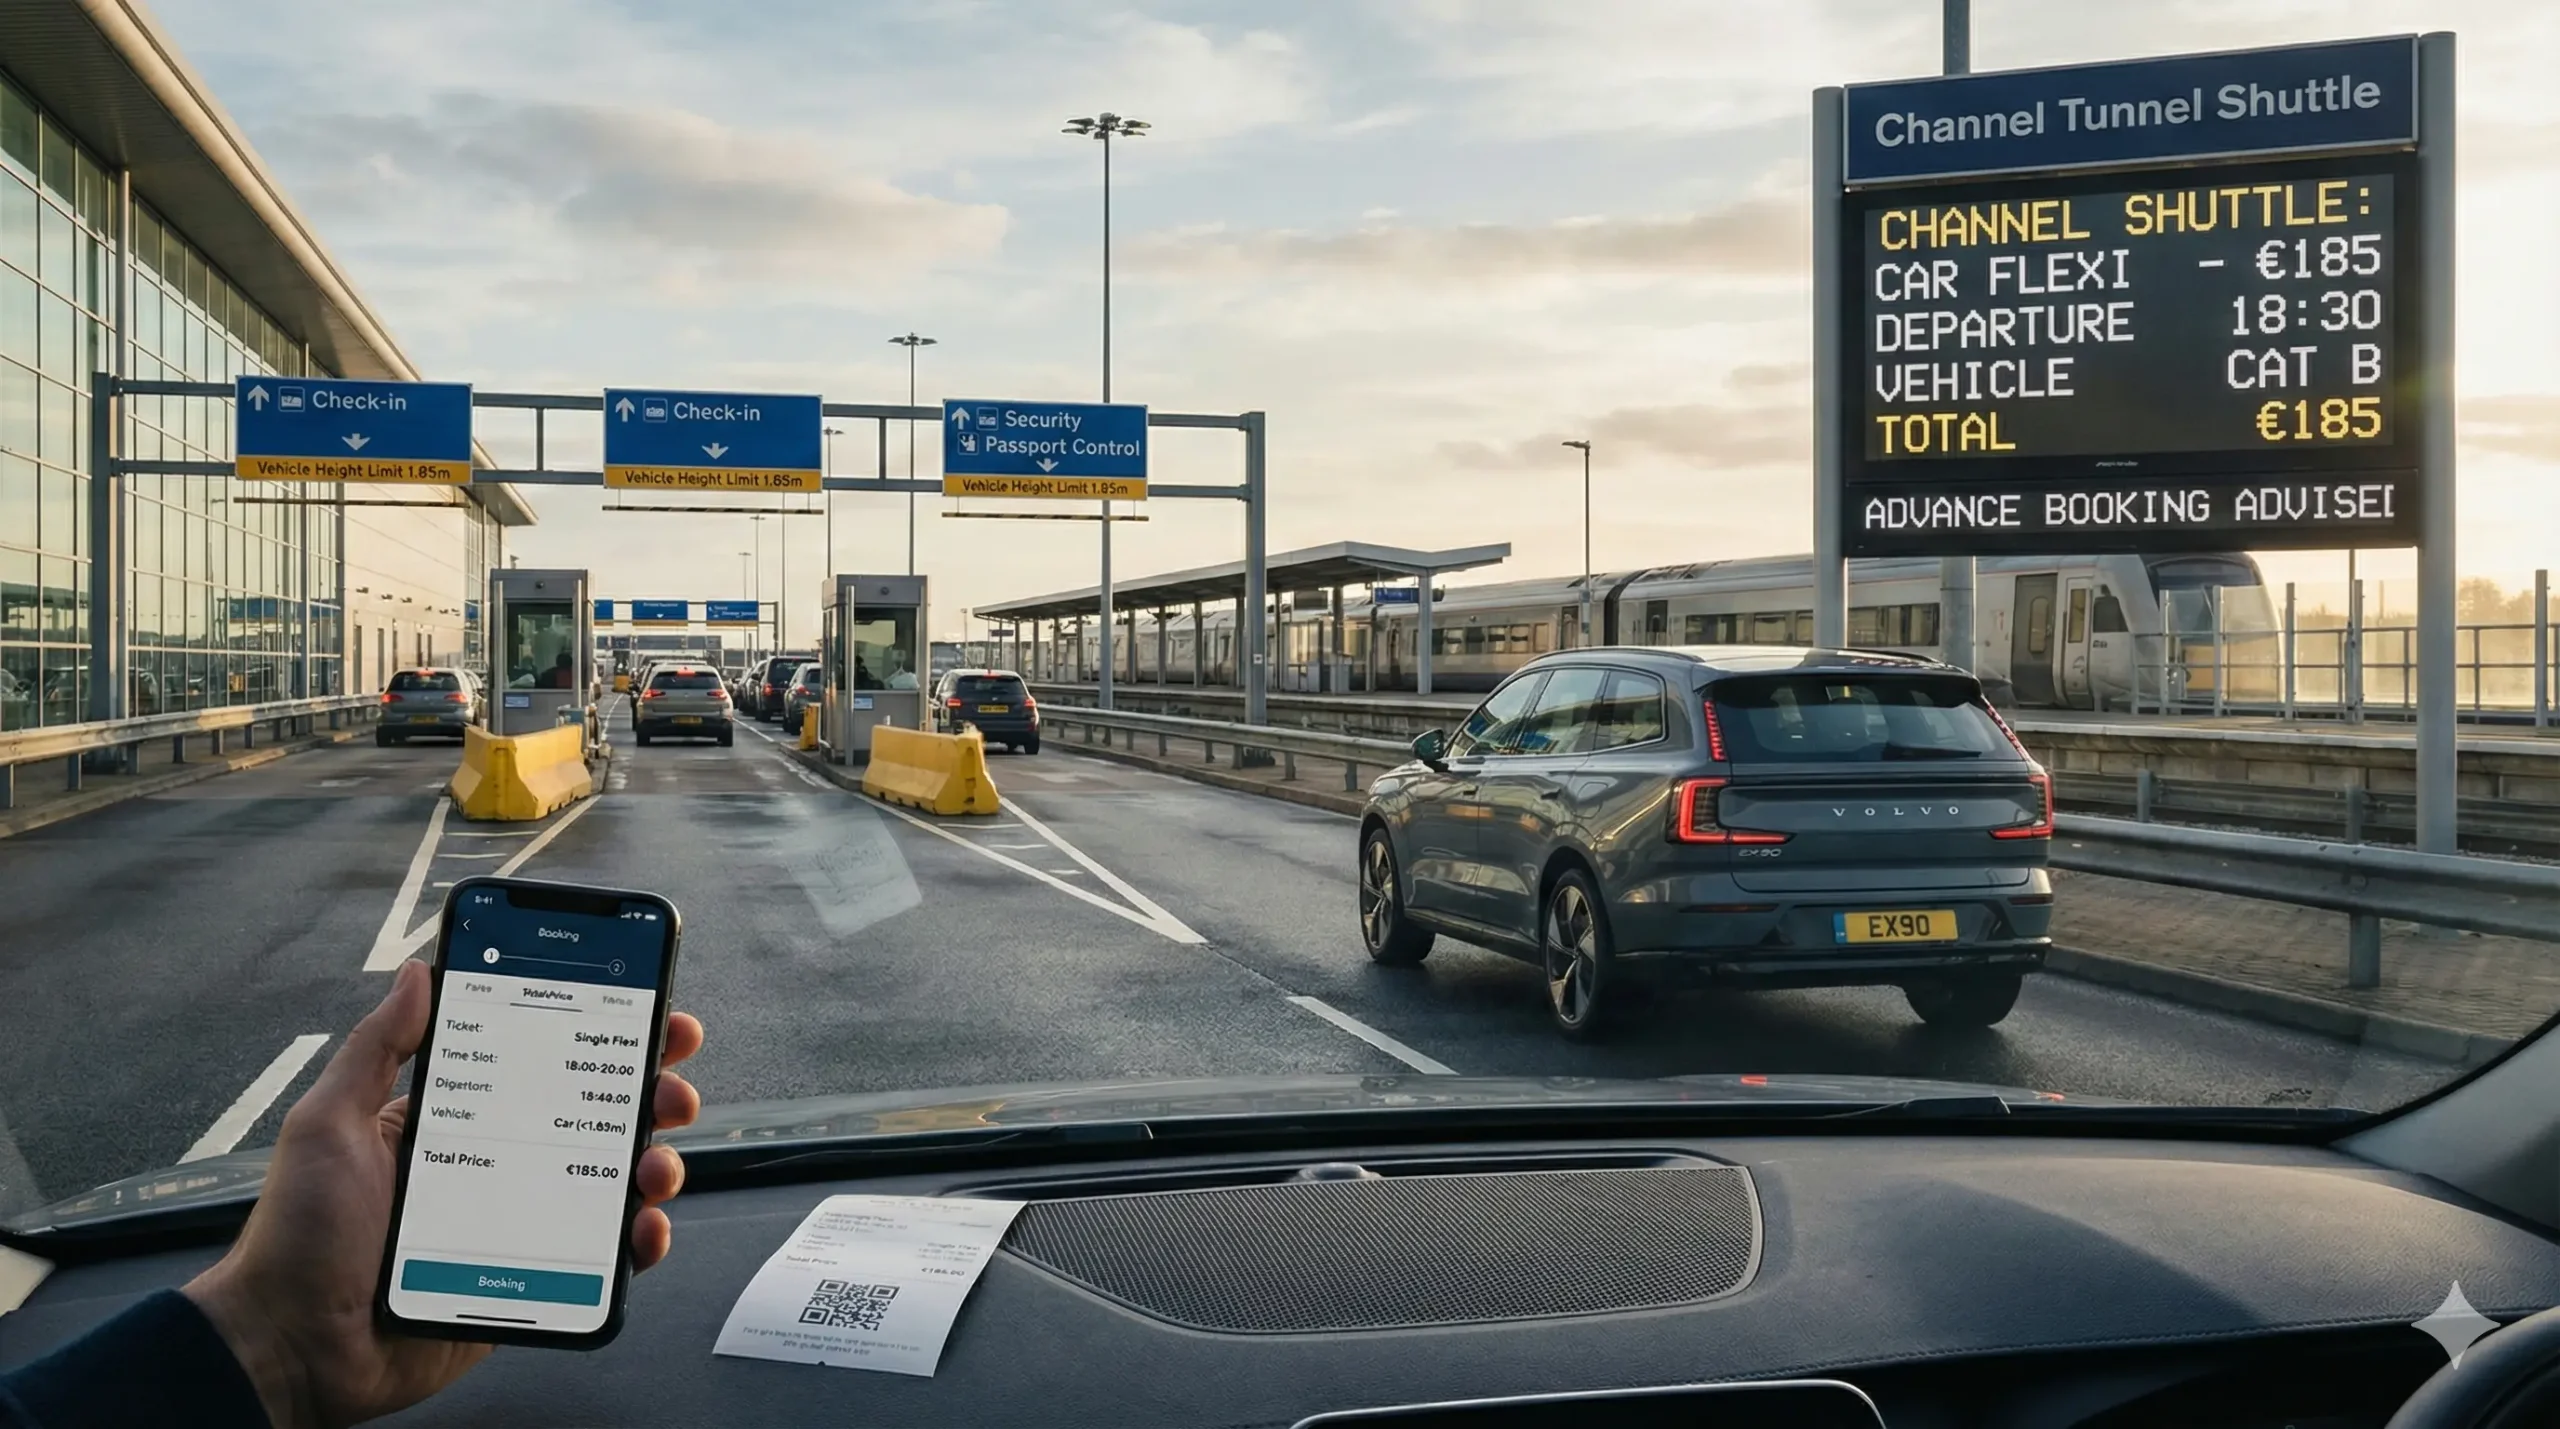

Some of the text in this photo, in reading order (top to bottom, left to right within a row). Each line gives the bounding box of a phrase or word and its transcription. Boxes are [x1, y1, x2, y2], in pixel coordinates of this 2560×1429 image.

[1875, 74, 2381, 147] Channel Tunnel Shuttle
[1881, 180, 2370, 250] CHANNEL SHUTTLE:
[1875, 260, 1958, 301] CAR
[1990, 249, 2130, 296] FLEXI
[2255, 234, 2381, 279] €185
[1876, 289, 2381, 353] DEPARTURE 18:30
[1876, 344, 2381, 403] VEHICLE CAT B
[312, 390, 407, 411] Check-in
[674, 402, 761, 421] Check-in
[1005, 410, 1082, 433] Security
[1876, 397, 2381, 454] TOTAL €185
[985, 436, 1140, 456] Passport Control
[257, 461, 450, 480] Vehicle Height Limit 1.85m
[625, 471, 674, 485] Vehicle
[678, 472, 721, 488] Height
[963, 479, 1008, 492] Vehicle
[1012, 479, 1053, 495] Height
[1865, 495, 2021, 530] ADVANCE
[2045, 490, 2210, 526] BOOKING
[1832, 805, 1959, 817] VOLVO
[538, 927, 580, 942] Booking
[1868, 914, 1930, 938] EX90
[446, 1019, 484, 1033] Ticket:
[574, 1031, 609, 1047] Single
[441, 1048, 498, 1064] Time Slot:
[431, 1106, 476, 1121] Vehicle:
[553, 1117, 574, 1129] Car
[424, 1150, 495, 1168] Total Price:
[566, 1164, 619, 1179] €185.00
